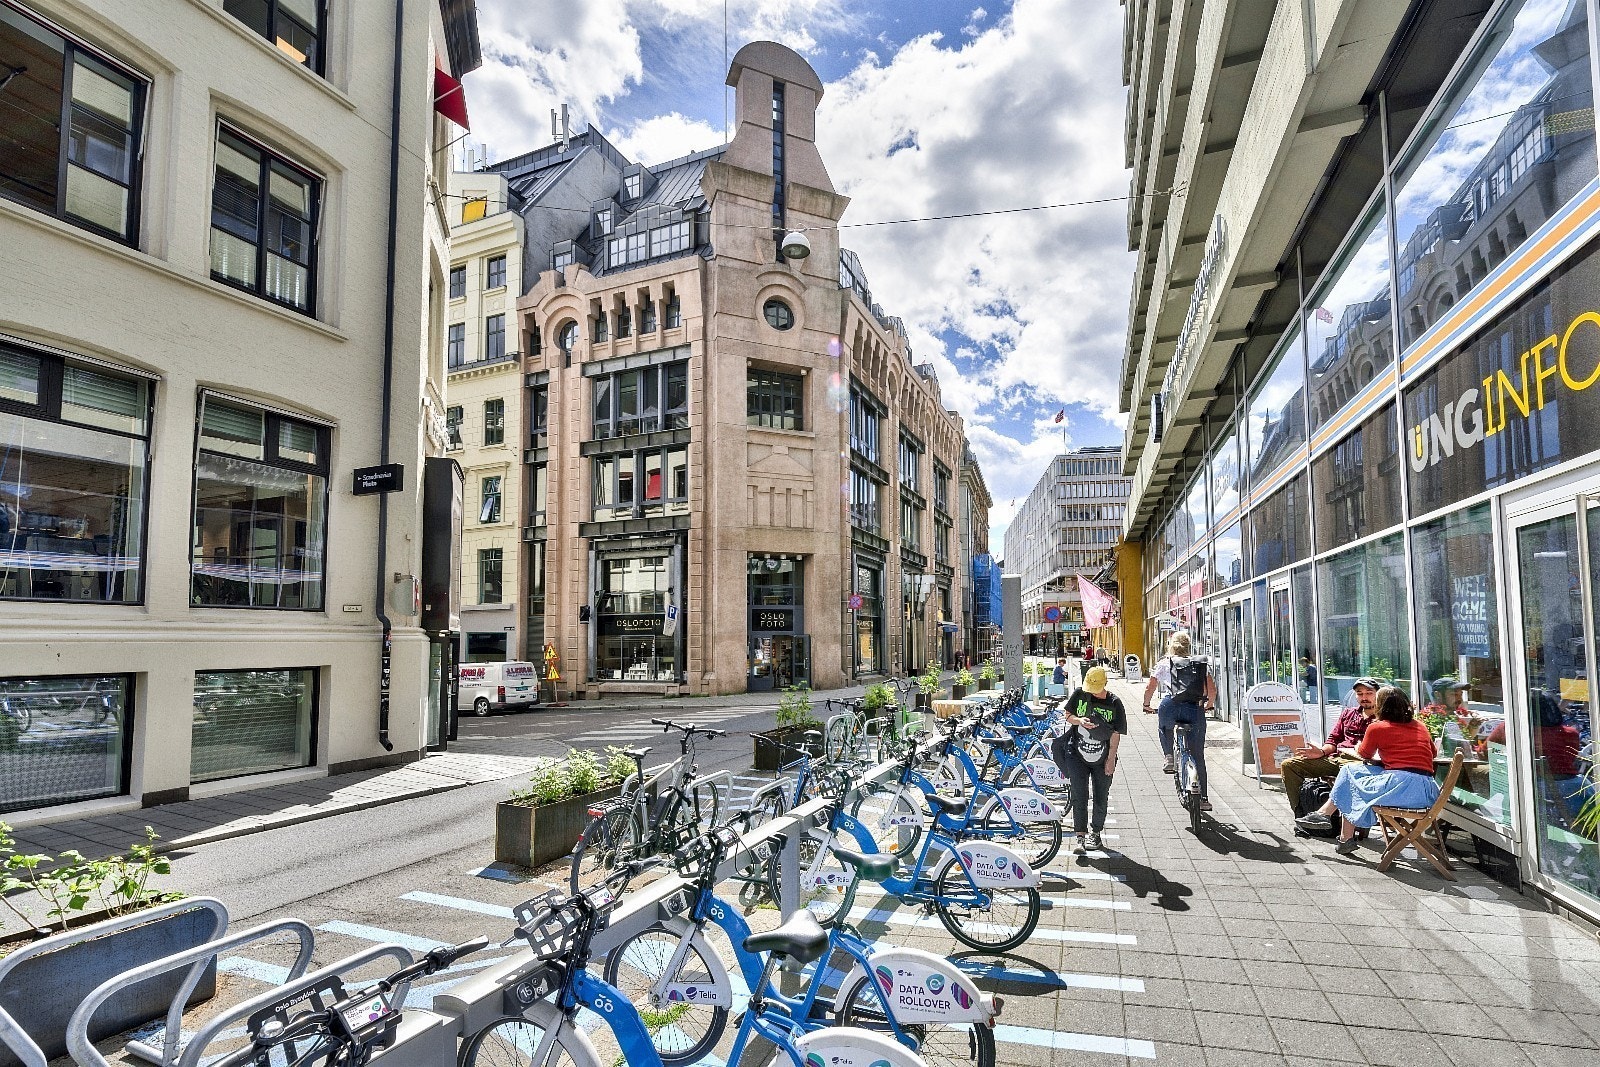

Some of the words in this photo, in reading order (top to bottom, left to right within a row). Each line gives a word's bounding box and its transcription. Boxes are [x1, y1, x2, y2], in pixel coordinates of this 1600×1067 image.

[760, 612, 785, 620] OSLO
[1452, 600, 1487, 621] COME
[760, 620, 785, 628] FOTO
[976, 862, 994, 870] DATA
[976, 869, 1011, 880] ROLLOVER
[520, 985, 533, 998] 15
[698, 990, 717, 1000] Telia
[899, 984, 925, 996] DATA
[274, 1002, 290, 1013] Oslo
[899, 995, 951, 1010] ROLLOVER
